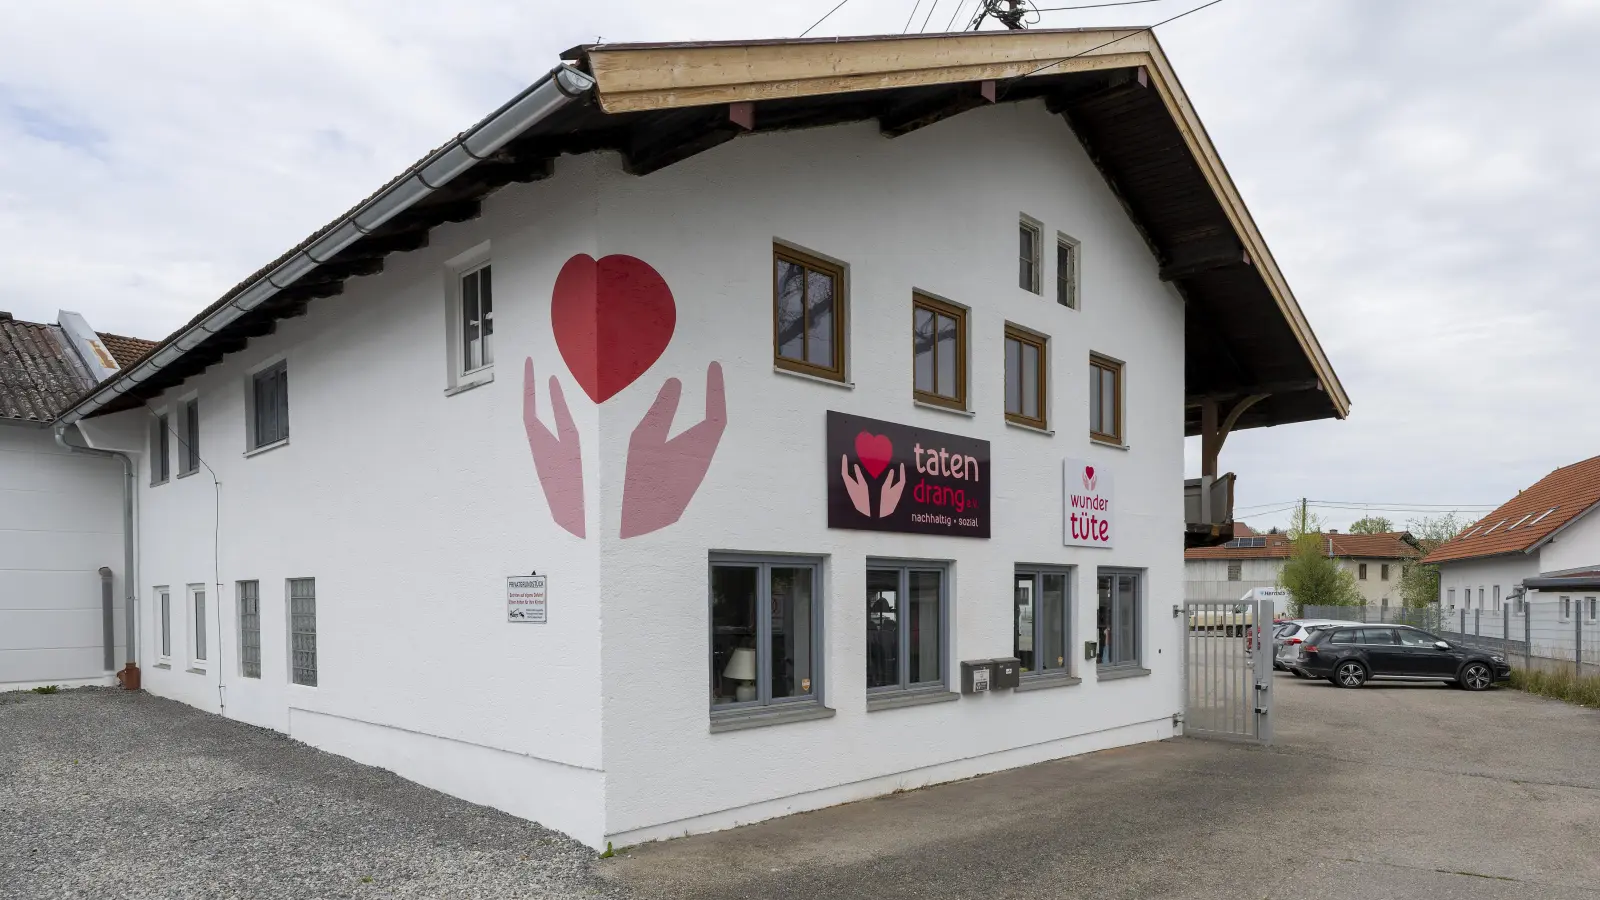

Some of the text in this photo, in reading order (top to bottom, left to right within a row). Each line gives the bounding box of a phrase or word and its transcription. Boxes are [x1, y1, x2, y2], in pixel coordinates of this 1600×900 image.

[913, 443, 979, 482] taten
[913, 478, 965, 513] drang
[1070, 494, 1109, 511] wunder
[911, 512, 979, 527] nachhaltig sozial
[1070, 511, 1109, 542] tüte
